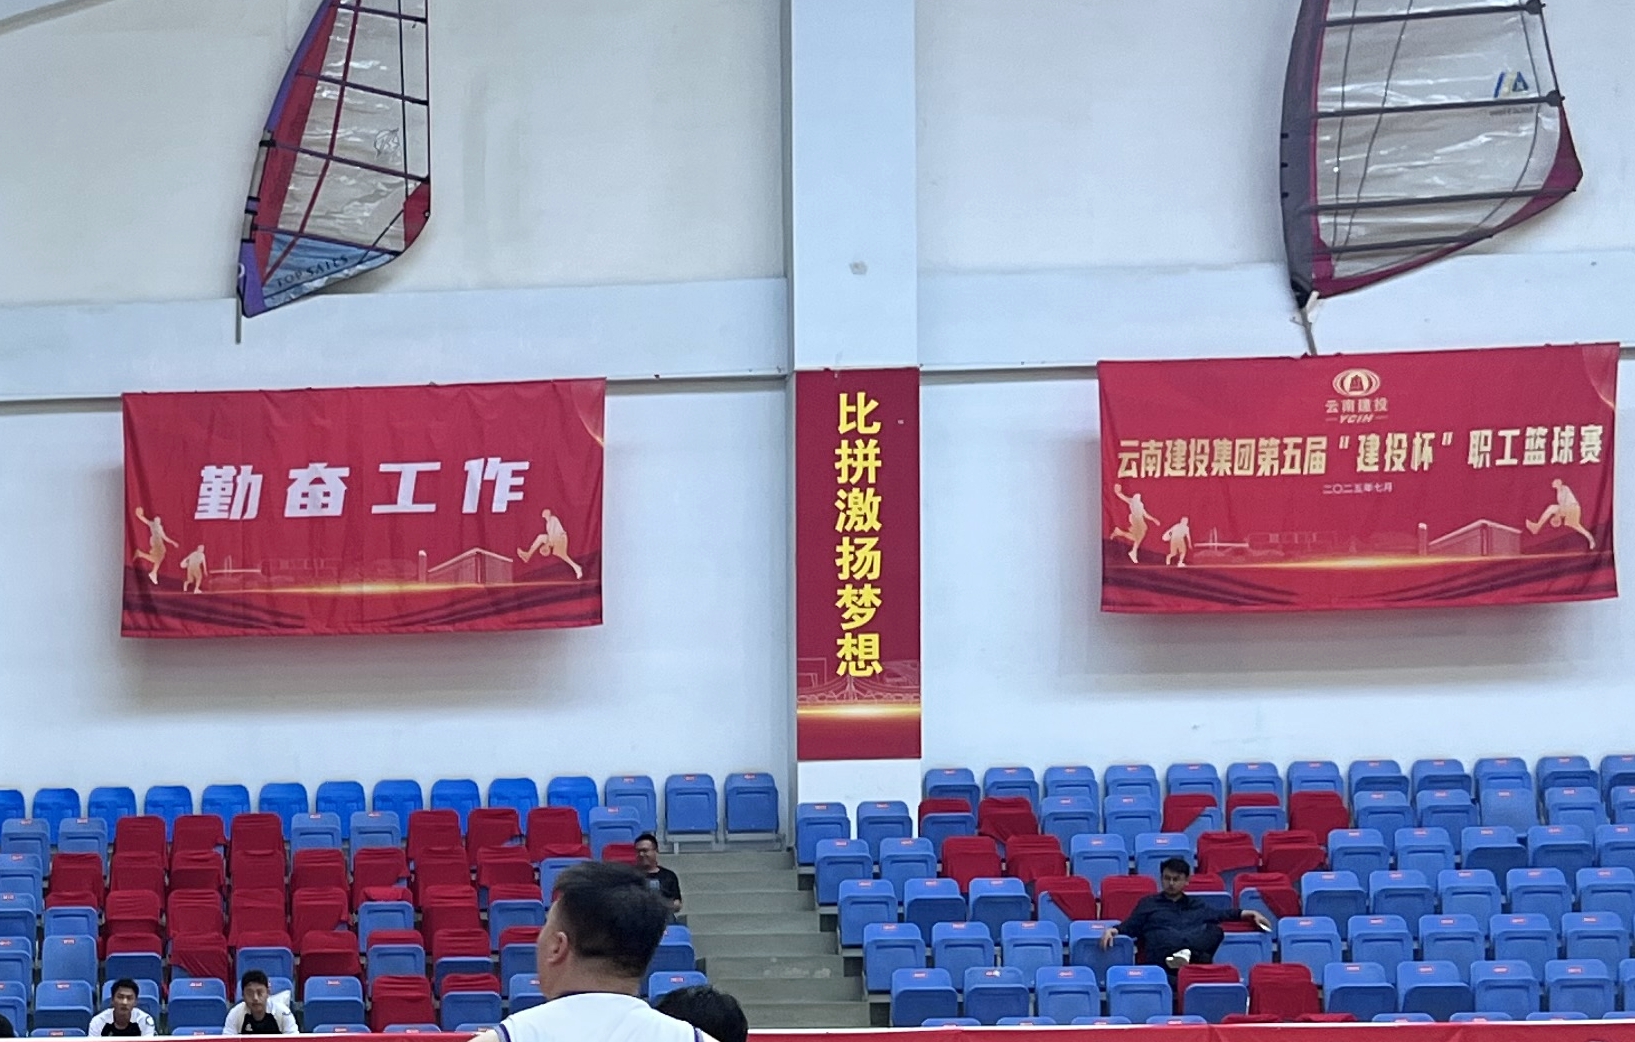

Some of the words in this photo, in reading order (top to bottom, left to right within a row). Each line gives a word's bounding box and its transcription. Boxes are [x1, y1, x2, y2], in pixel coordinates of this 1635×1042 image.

[194, 457, 530, 521] 勤奋工作
[834, 391, 883, 677] 比拼激扬梦想
